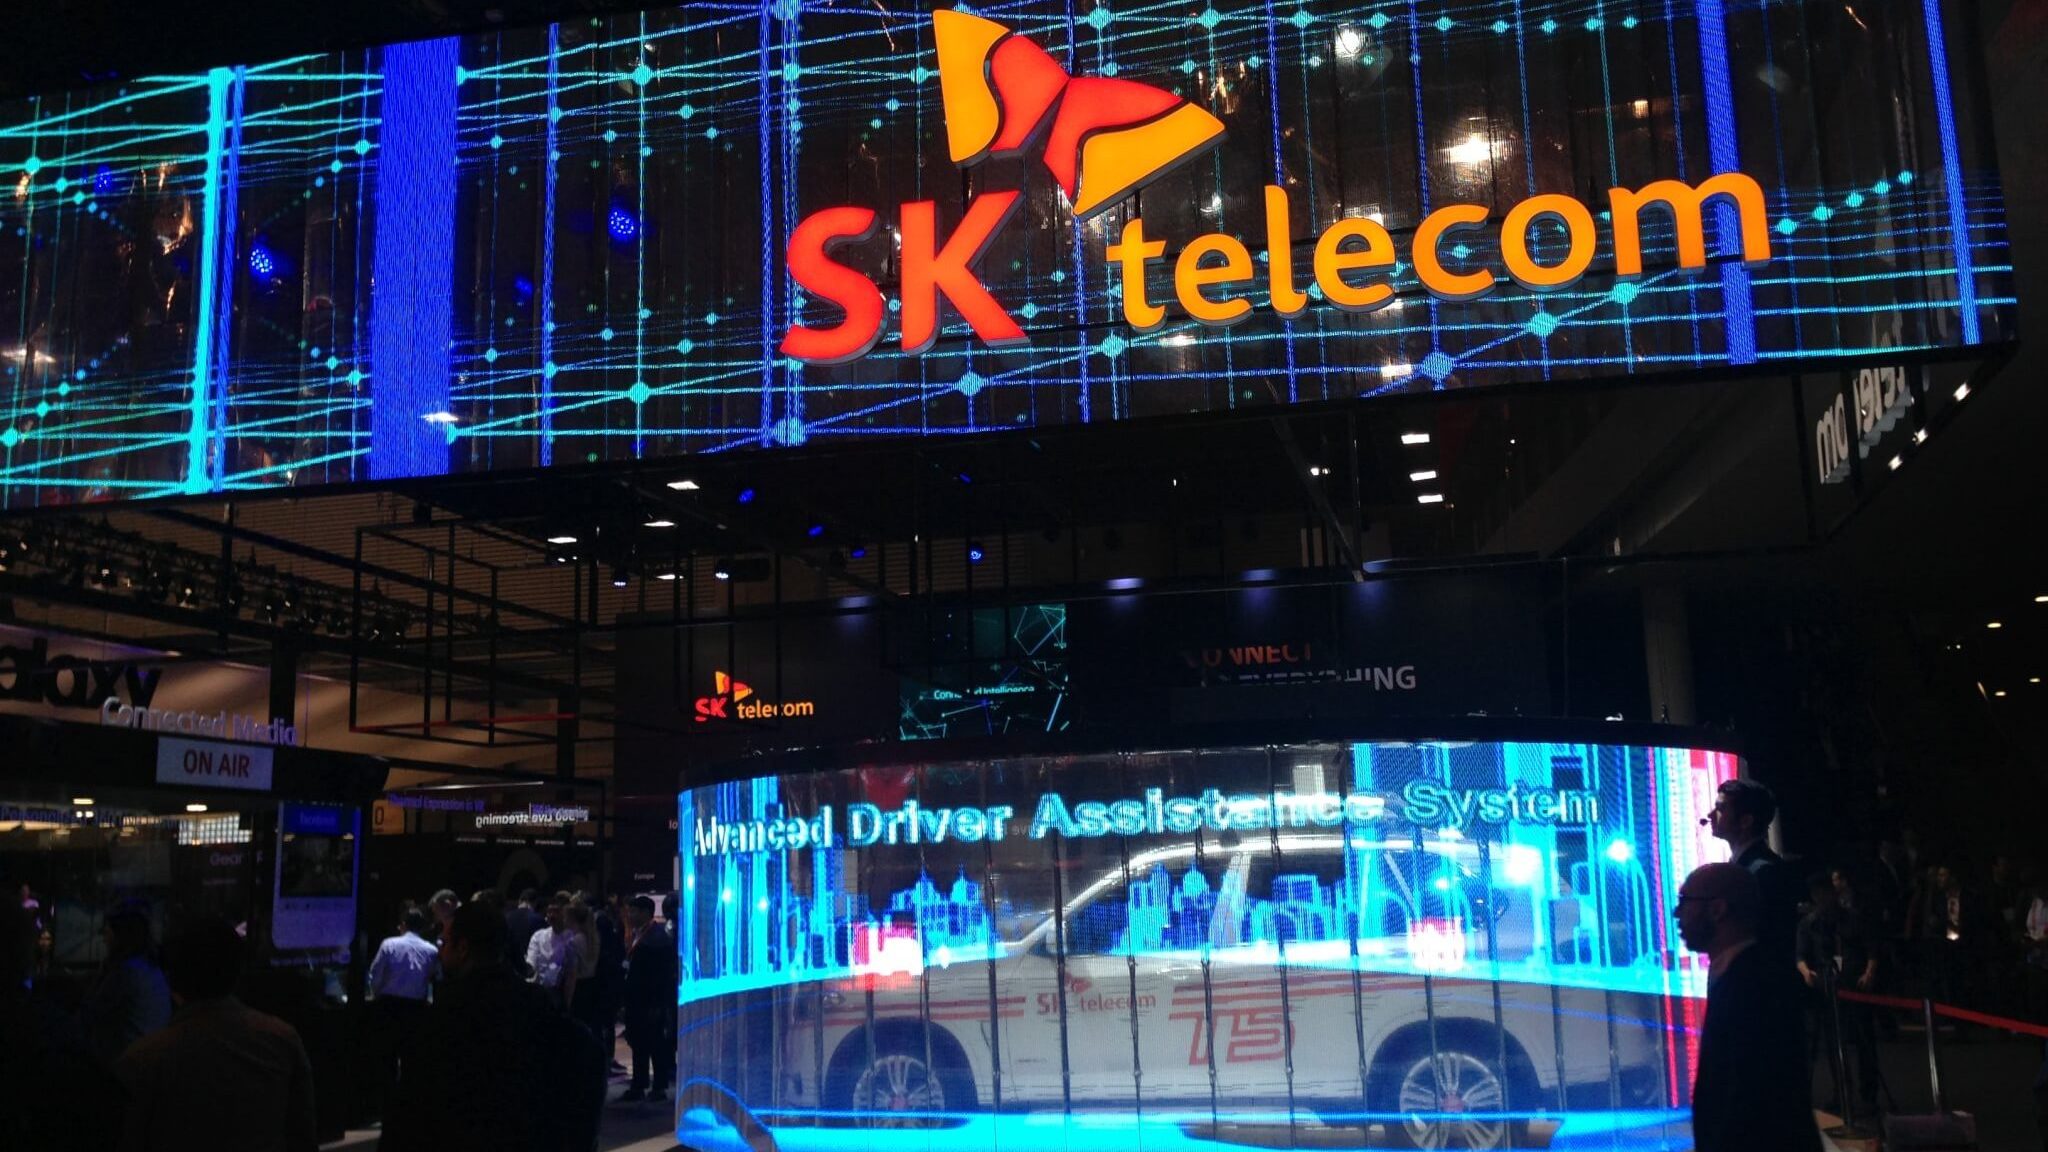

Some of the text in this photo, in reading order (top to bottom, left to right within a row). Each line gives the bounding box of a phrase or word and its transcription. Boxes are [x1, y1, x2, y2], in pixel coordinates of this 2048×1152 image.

[779, 172, 1772, 364] SK telecom
[102, 696, 297, 746] Connected Media
[695, 697, 814, 721] SK telecom
[183, 748, 250, 778] ON AIR
[694, 778, 1598, 857] Advanced Driver Assistance System
